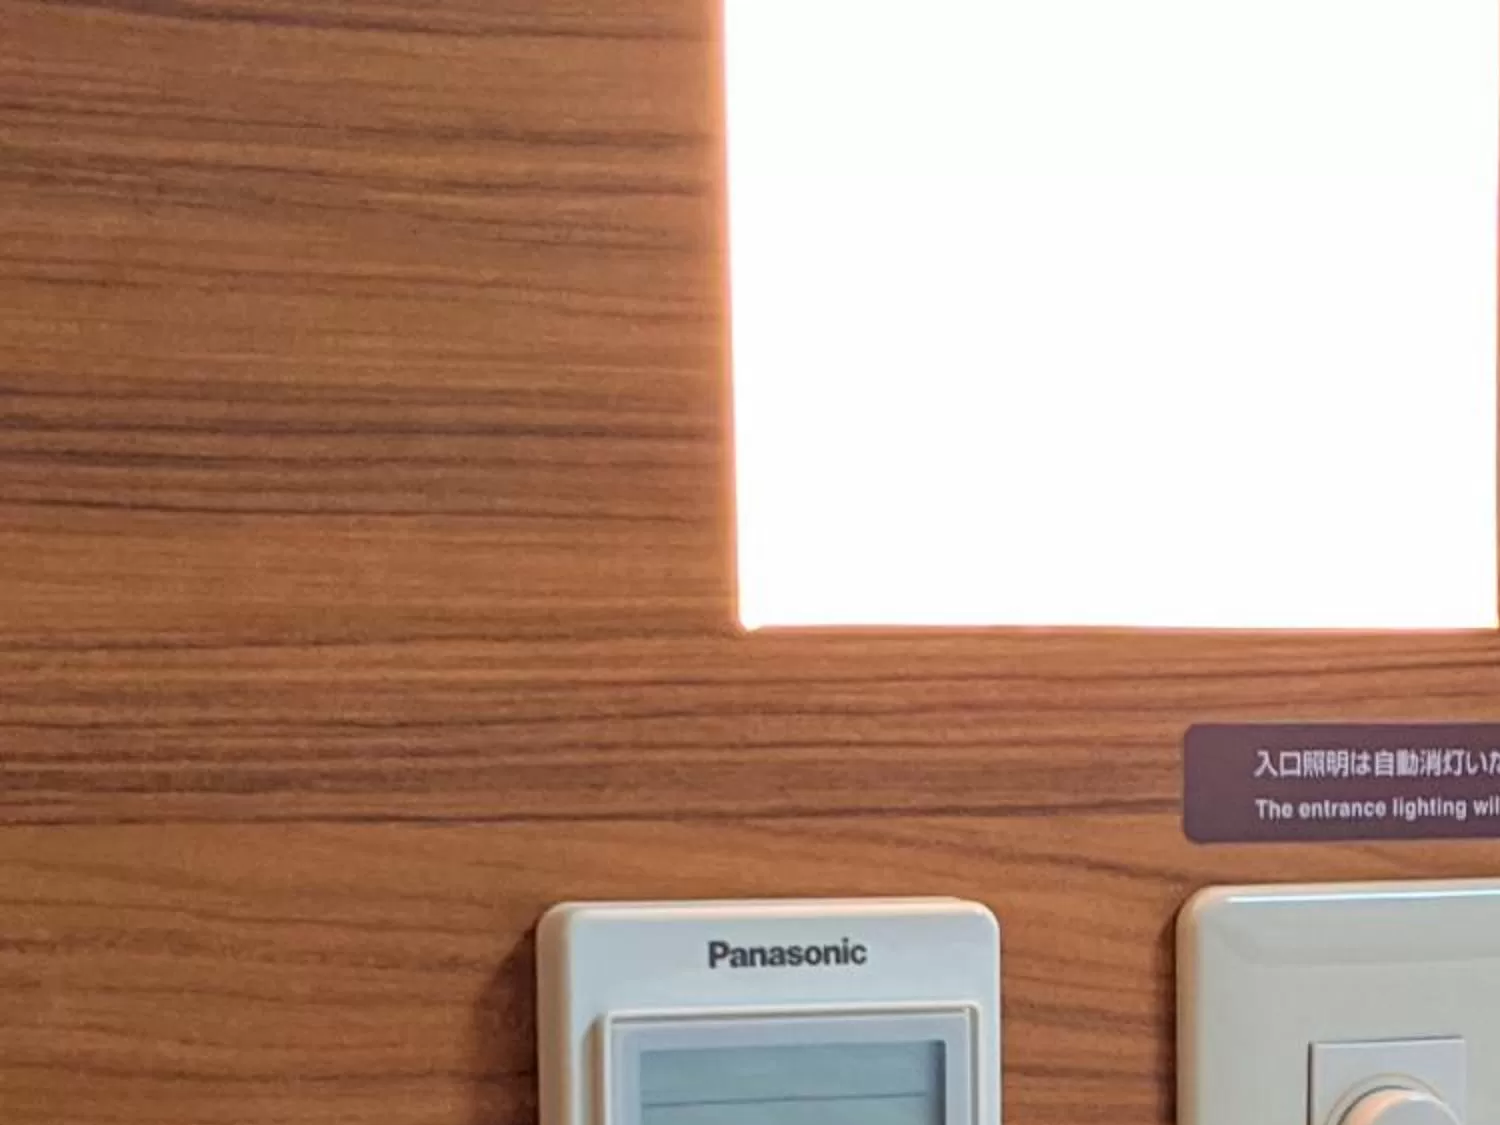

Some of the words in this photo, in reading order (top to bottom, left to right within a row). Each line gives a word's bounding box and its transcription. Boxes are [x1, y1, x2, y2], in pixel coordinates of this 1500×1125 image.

[1256, 798, 1293, 820] The
[1299, 798, 1387, 819] entrance
[1393, 796, 1467, 821] lighting
[707, 937, 868, 969] Panasonic
